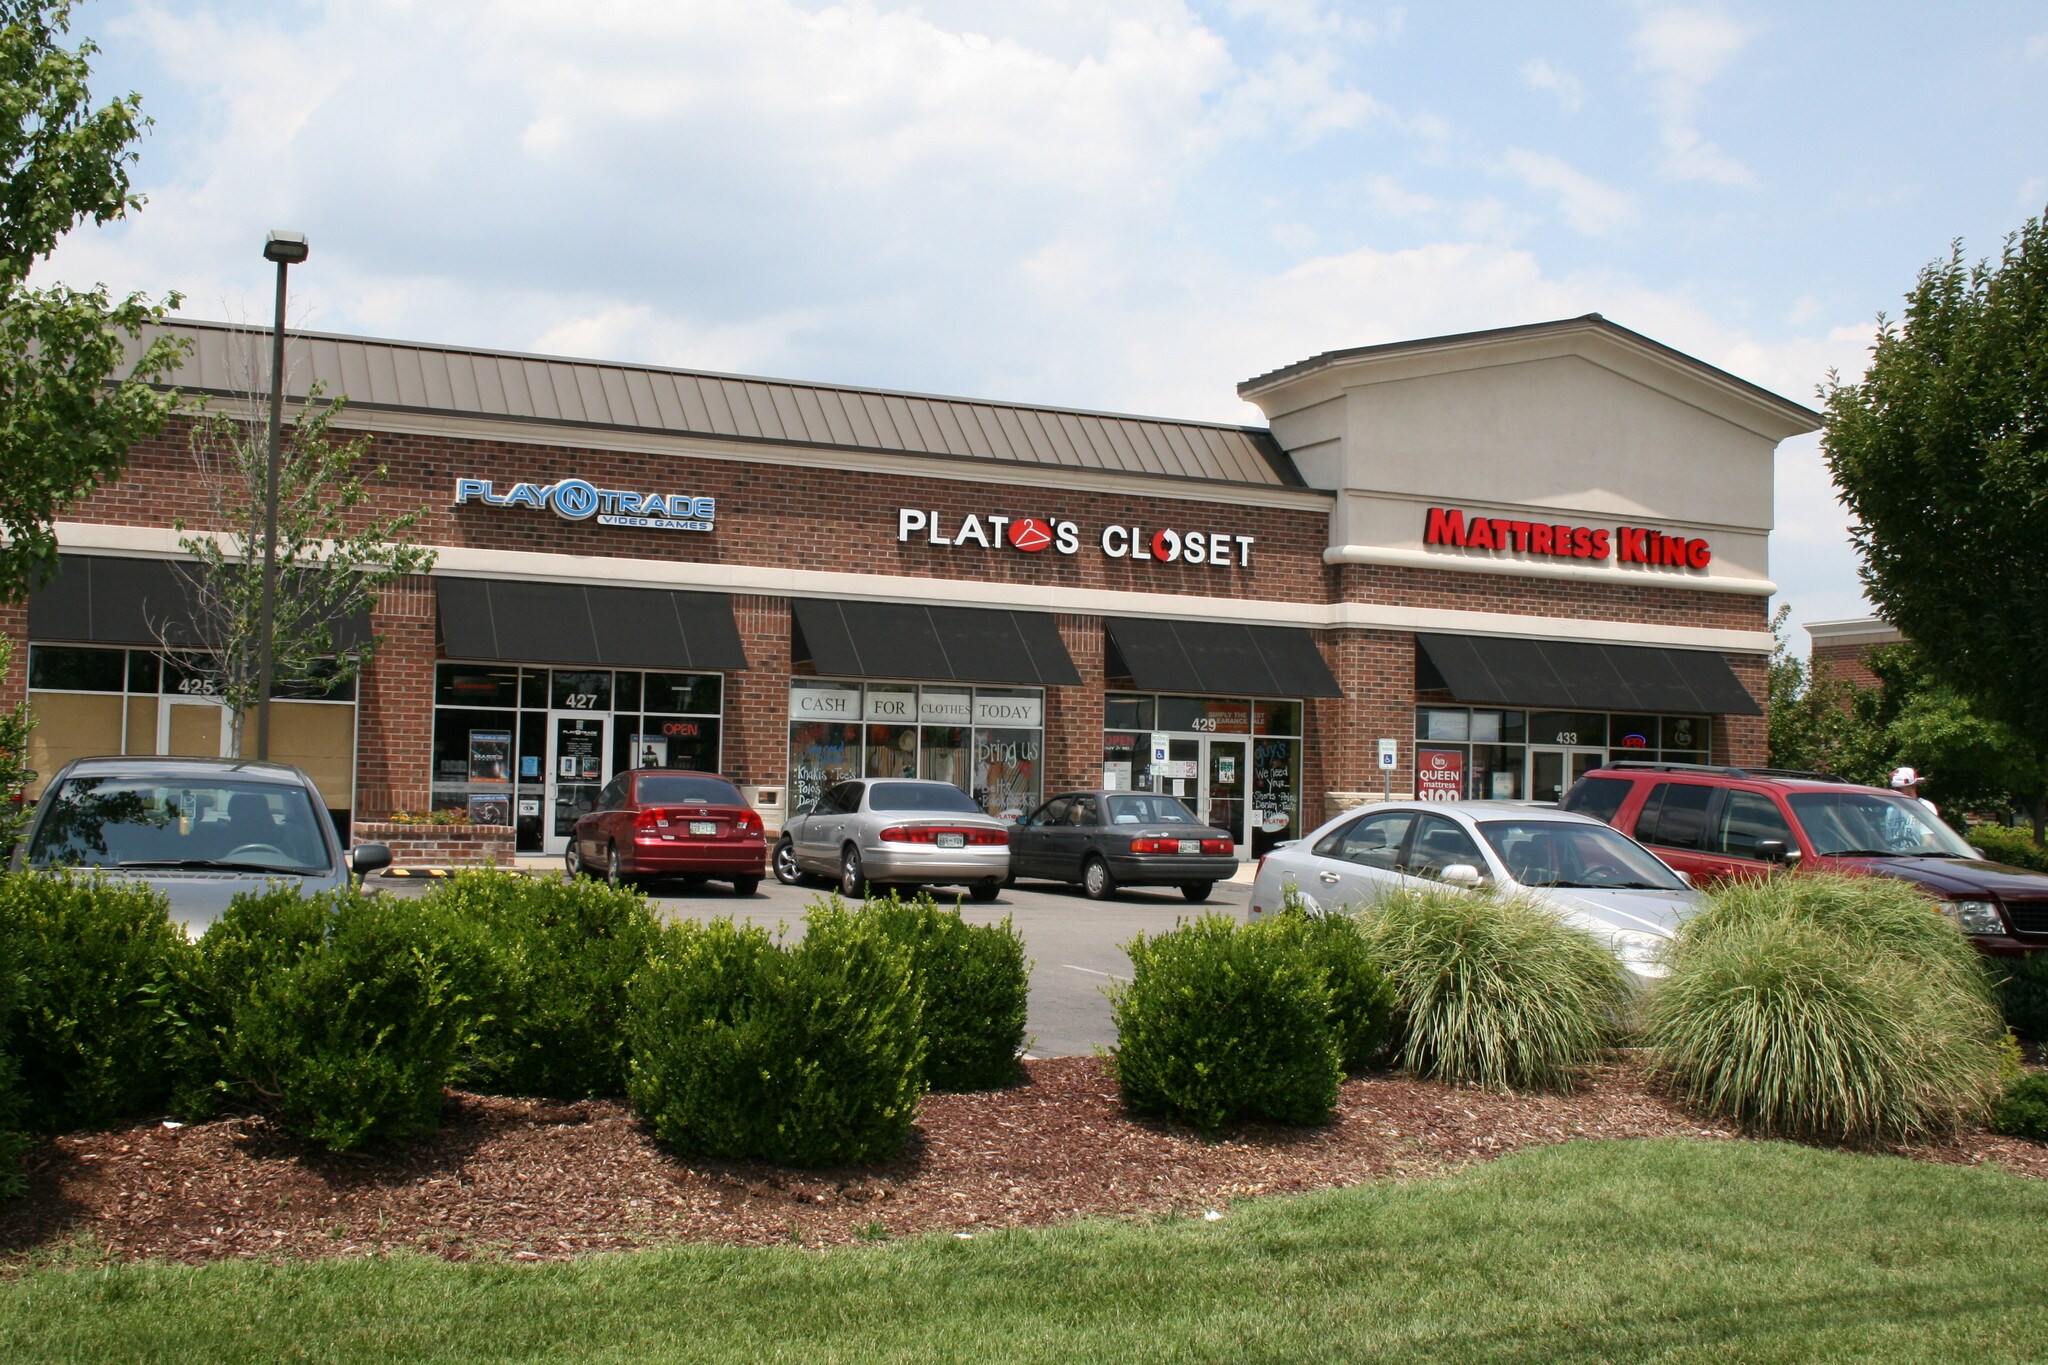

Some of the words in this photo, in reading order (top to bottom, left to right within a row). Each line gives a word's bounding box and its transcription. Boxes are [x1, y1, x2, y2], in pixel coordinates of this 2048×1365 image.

[456, 478, 556, 509] PLAY
[597, 488, 716, 520] TRADE
[603, 516, 648, 526] VIDEO
[654, 519, 708, 530] GAMES
[899, 508, 1080, 554] PLATO'S
[1102, 525, 1255, 567] CLOSET
[1423, 507, 1610, 559] MATTRESS
[178, 678, 214, 695] 425
[565, 693, 598, 709] 427
[801, 697, 847, 712] CASH
[874, 701, 905, 715] FOR
[921, 704, 972, 715] CLOTHES
[979, 704, 1032, 719] TODAY
[663, 723, 698, 736] OPEN
[1192, 718, 1217, 732] 429
[1105, 735, 1135, 746] OPEN
[1556, 732, 1578, 745] 433
[978, 737, 1017, 769] Bring
[1021, 742, 1039, 760] us
[797, 765, 828, 780] Khakis
[1255, 768, 1269, 779] We
[1270, 766, 1288, 777] need
[1420, 770, 1460, 781] QUEEN
[1423, 781, 1456, 789] mattress
